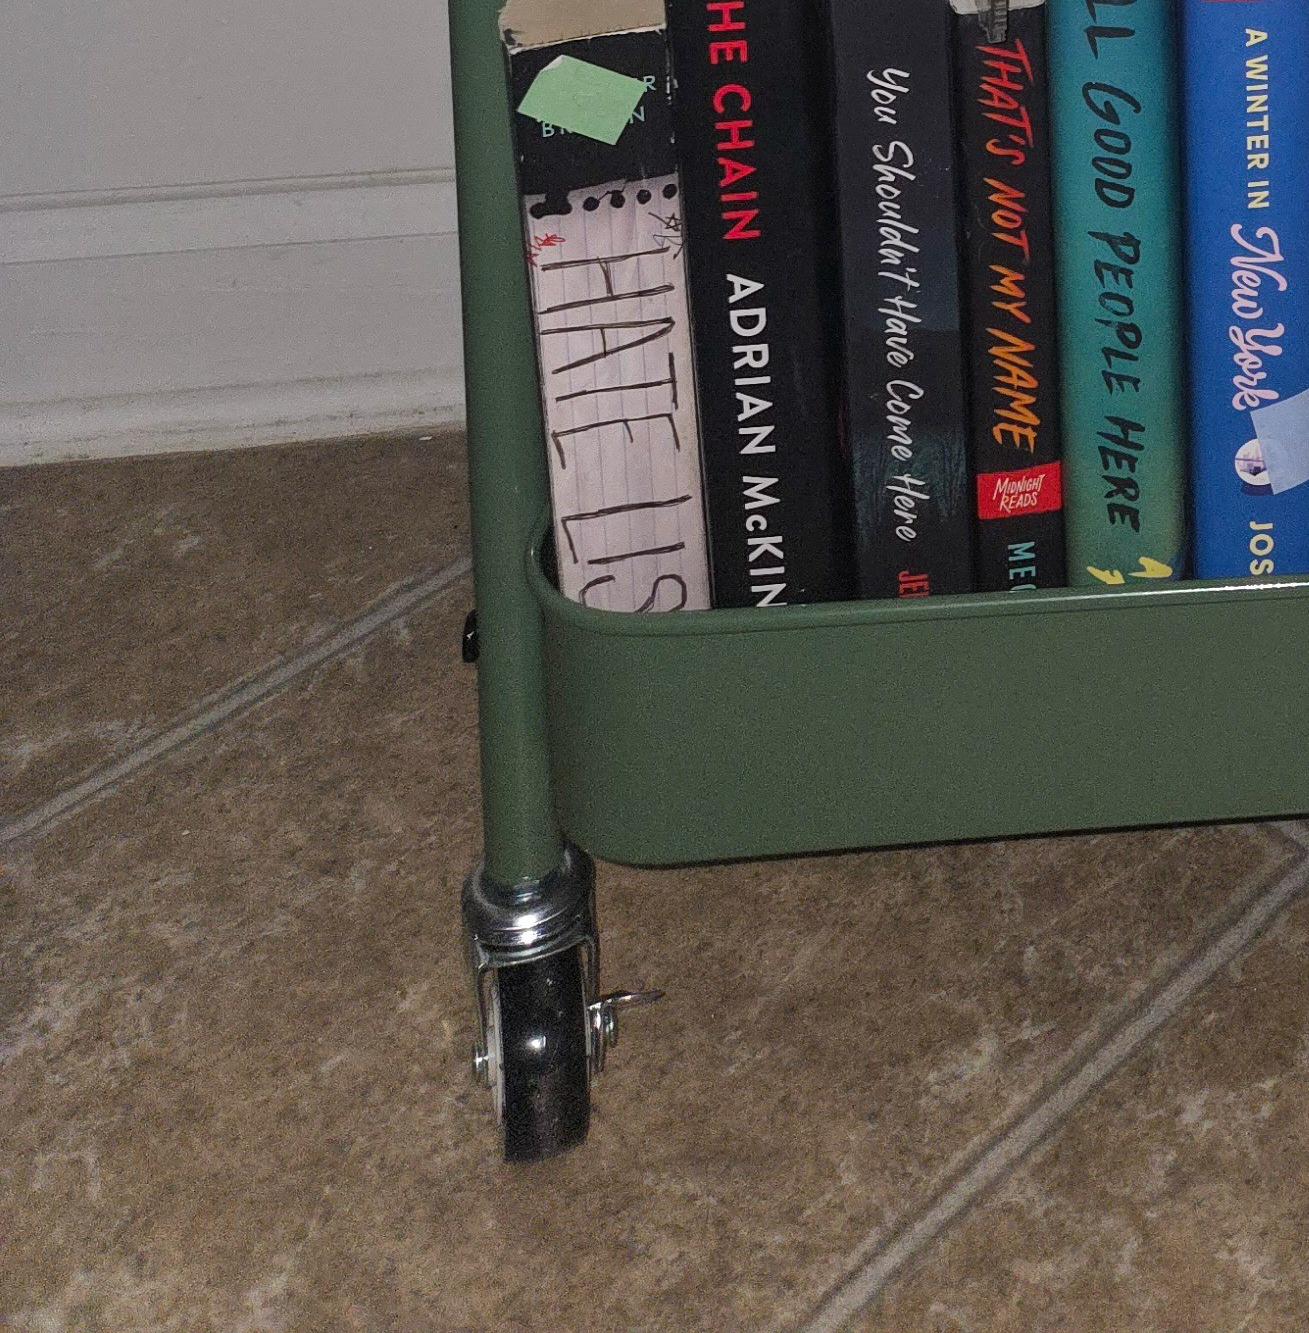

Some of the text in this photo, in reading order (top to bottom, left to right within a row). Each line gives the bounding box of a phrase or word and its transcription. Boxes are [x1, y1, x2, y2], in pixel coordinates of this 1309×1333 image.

[1244, 27, 1268, 46] A
[712, 83, 760, 242] CHAIN
[1082, 80, 1142, 210] GOOD
[1246, 53, 1271, 171] WINTER
[976, 37, 1042, 454] THAT'S NOT MY NAME
[1247, 179, 1271, 209] IN
[866, 67, 930, 597] You Shouldn't Have Come Here JE
[1088, 230, 1142, 394] PEOPLE
[1231, 226, 1288, 330] New
[538, 247, 680, 470] HATE
[725, 272, 776, 455] ADRIAN
[1230, 313, 1285, 411] York
[998, 491, 1038, 509] READS
[1093, 414, 1145, 534] HERE
